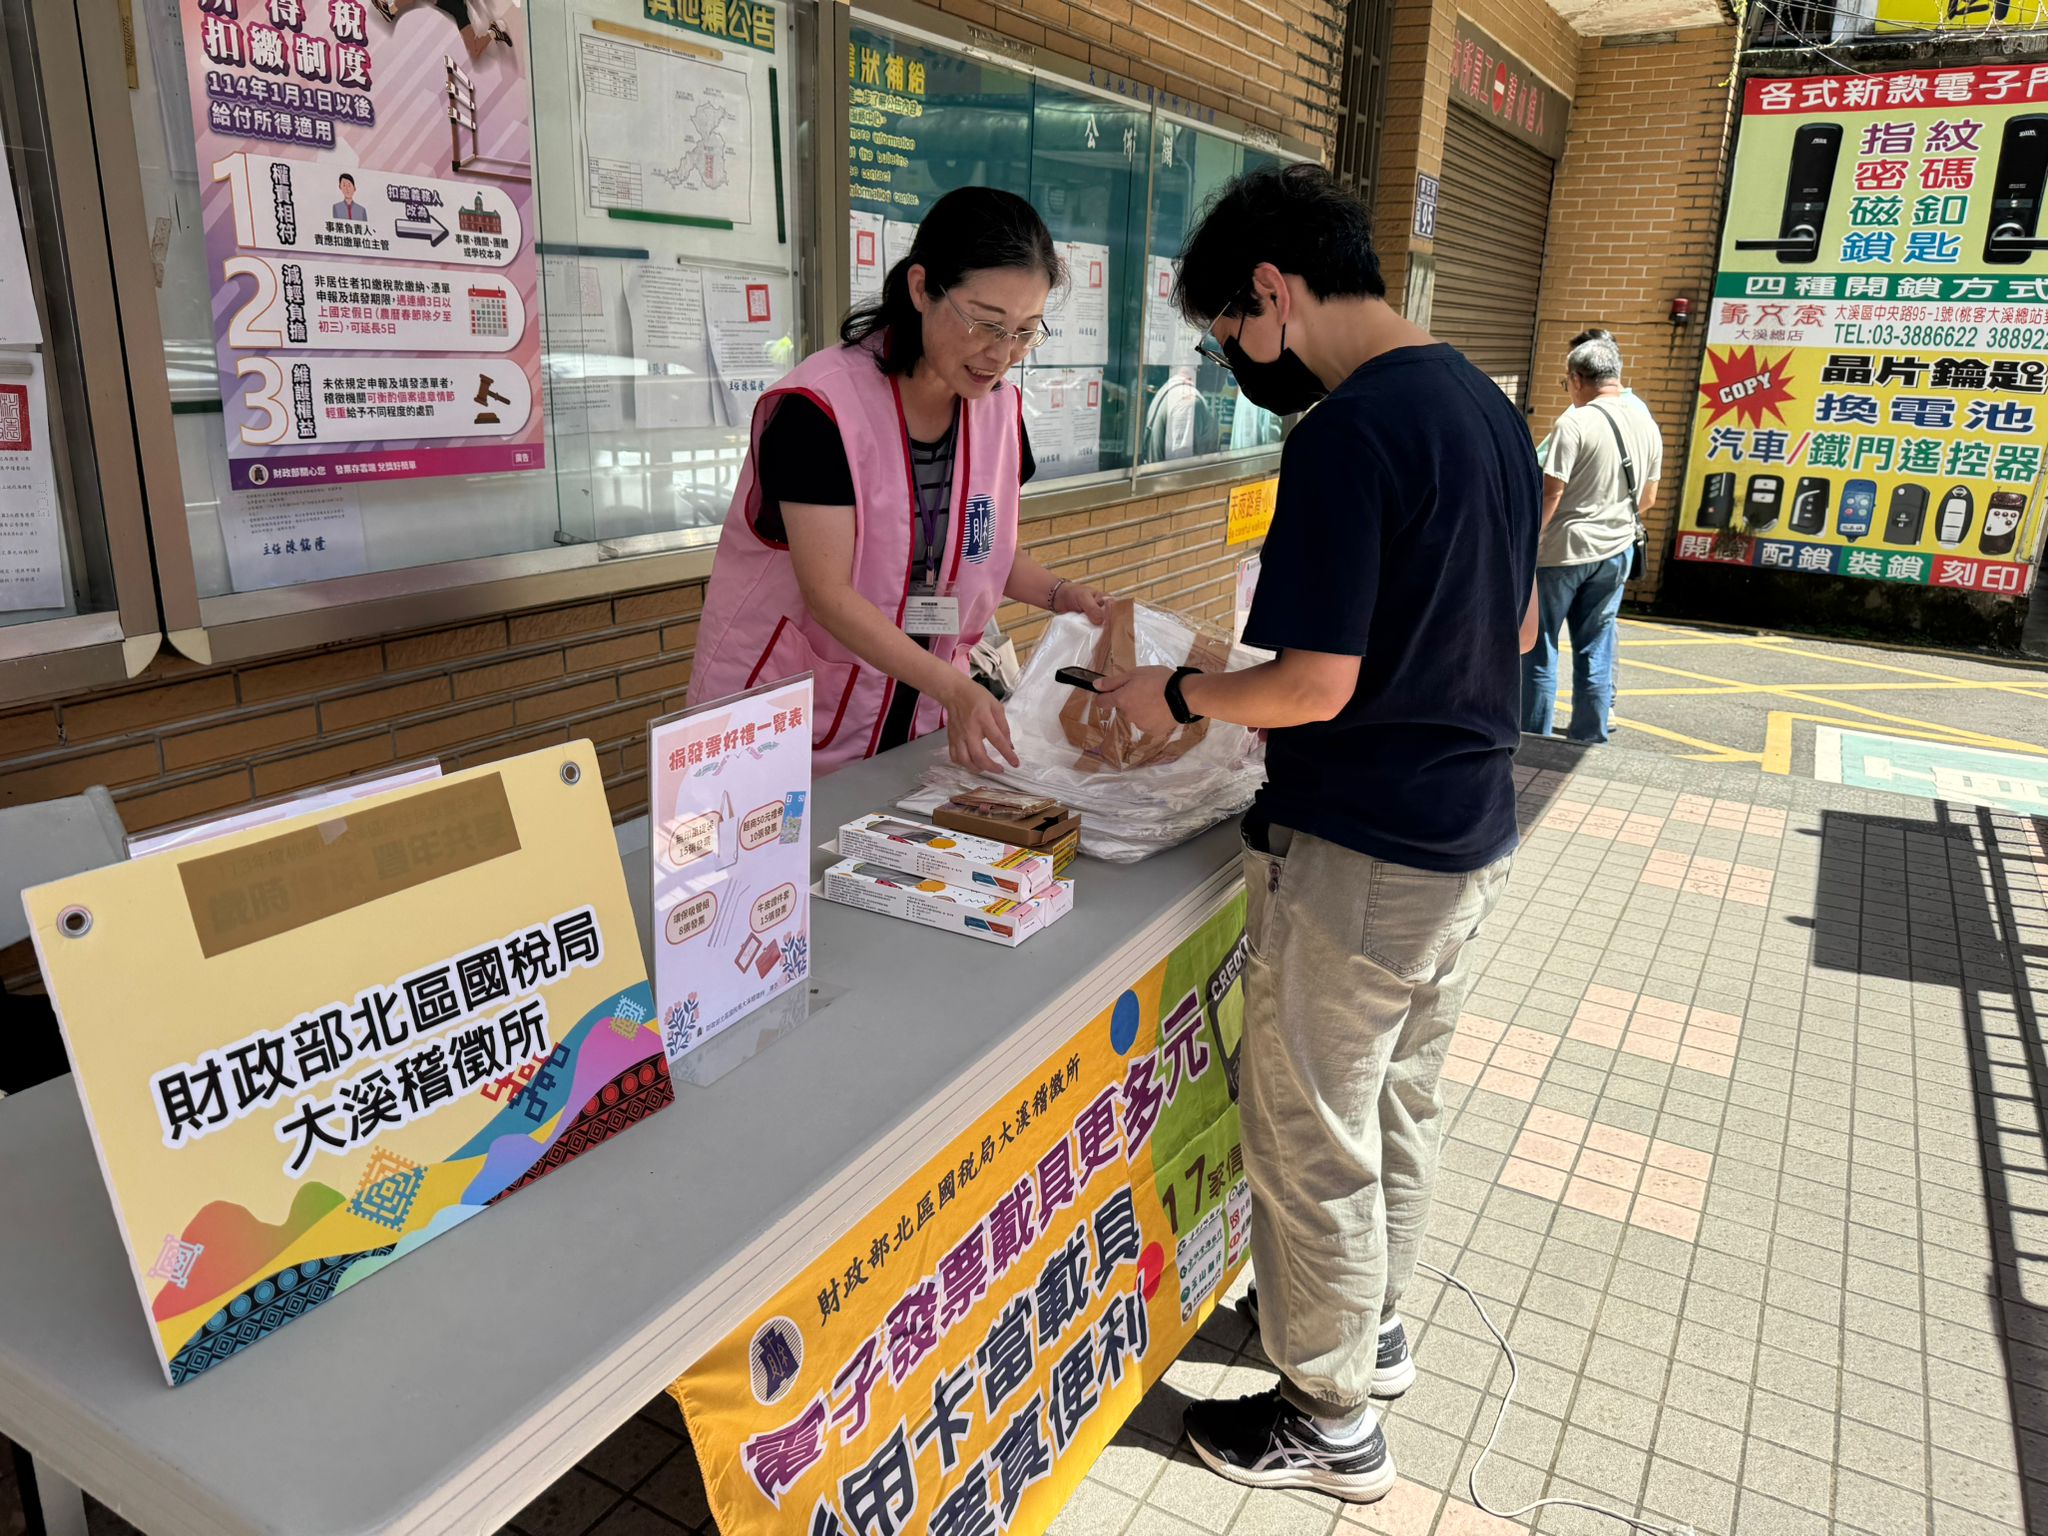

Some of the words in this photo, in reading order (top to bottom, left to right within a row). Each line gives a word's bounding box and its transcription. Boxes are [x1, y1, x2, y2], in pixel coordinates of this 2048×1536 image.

[203, 17, 370, 87] 扣繳制度
[208, 73, 373, 121] 114年1月1日以後
[210, 102, 334, 143] 給付所得適用
[1860, 119, 1984, 155] 指紋
[1855, 156, 1978, 191] 密碼
[212, 151, 255, 248] 1
[270, 162, 296, 245] 權責相符
[405, 205, 429, 220] 改為
[1421, 203, 1434, 235] 95
[1849, 194, 1968, 227] 磁釦
[1840, 231, 1962, 264] 鎖匙
[223, 255, 284, 349] 2
[282, 265, 308, 343] 減輕負擔
[1746, 276, 2048, 299] 四種開鎖方式
[1734, 329, 1804, 342] 大溪總店
[1833, 323, 1978, 348] TEL:03-3886622
[1718, 370, 1773, 405] COPY
[1820, 354, 2048, 394] 晶片鑰匙
[236, 356, 289, 445] 3
[292, 364, 317, 439] 維護權益
[1815, 393, 2034, 434] 換電池
[1707, 427, 2043, 484] 汽車/鐵門遙控器
[1679, 534, 1748, 563] 開
[1760, 543, 1834, 573] 配鎖
[1847, 550, 1924, 582] 裝鎖
[1938, 563, 2022, 593] 刻印
[668, 706, 804, 773] 捐發票好禮一覽表
[157, 910, 602, 1140] 財政部北區國稅局
[280, 1002, 548, 1170] 大溪稽徵所
[815, 1052, 1081, 1326] 財政部北區國稅局大溪稽徵所
[742, 993, 1210, 1508] 電子發票載具更多元
[812, 1186, 1141, 1536] 用卡當載具
